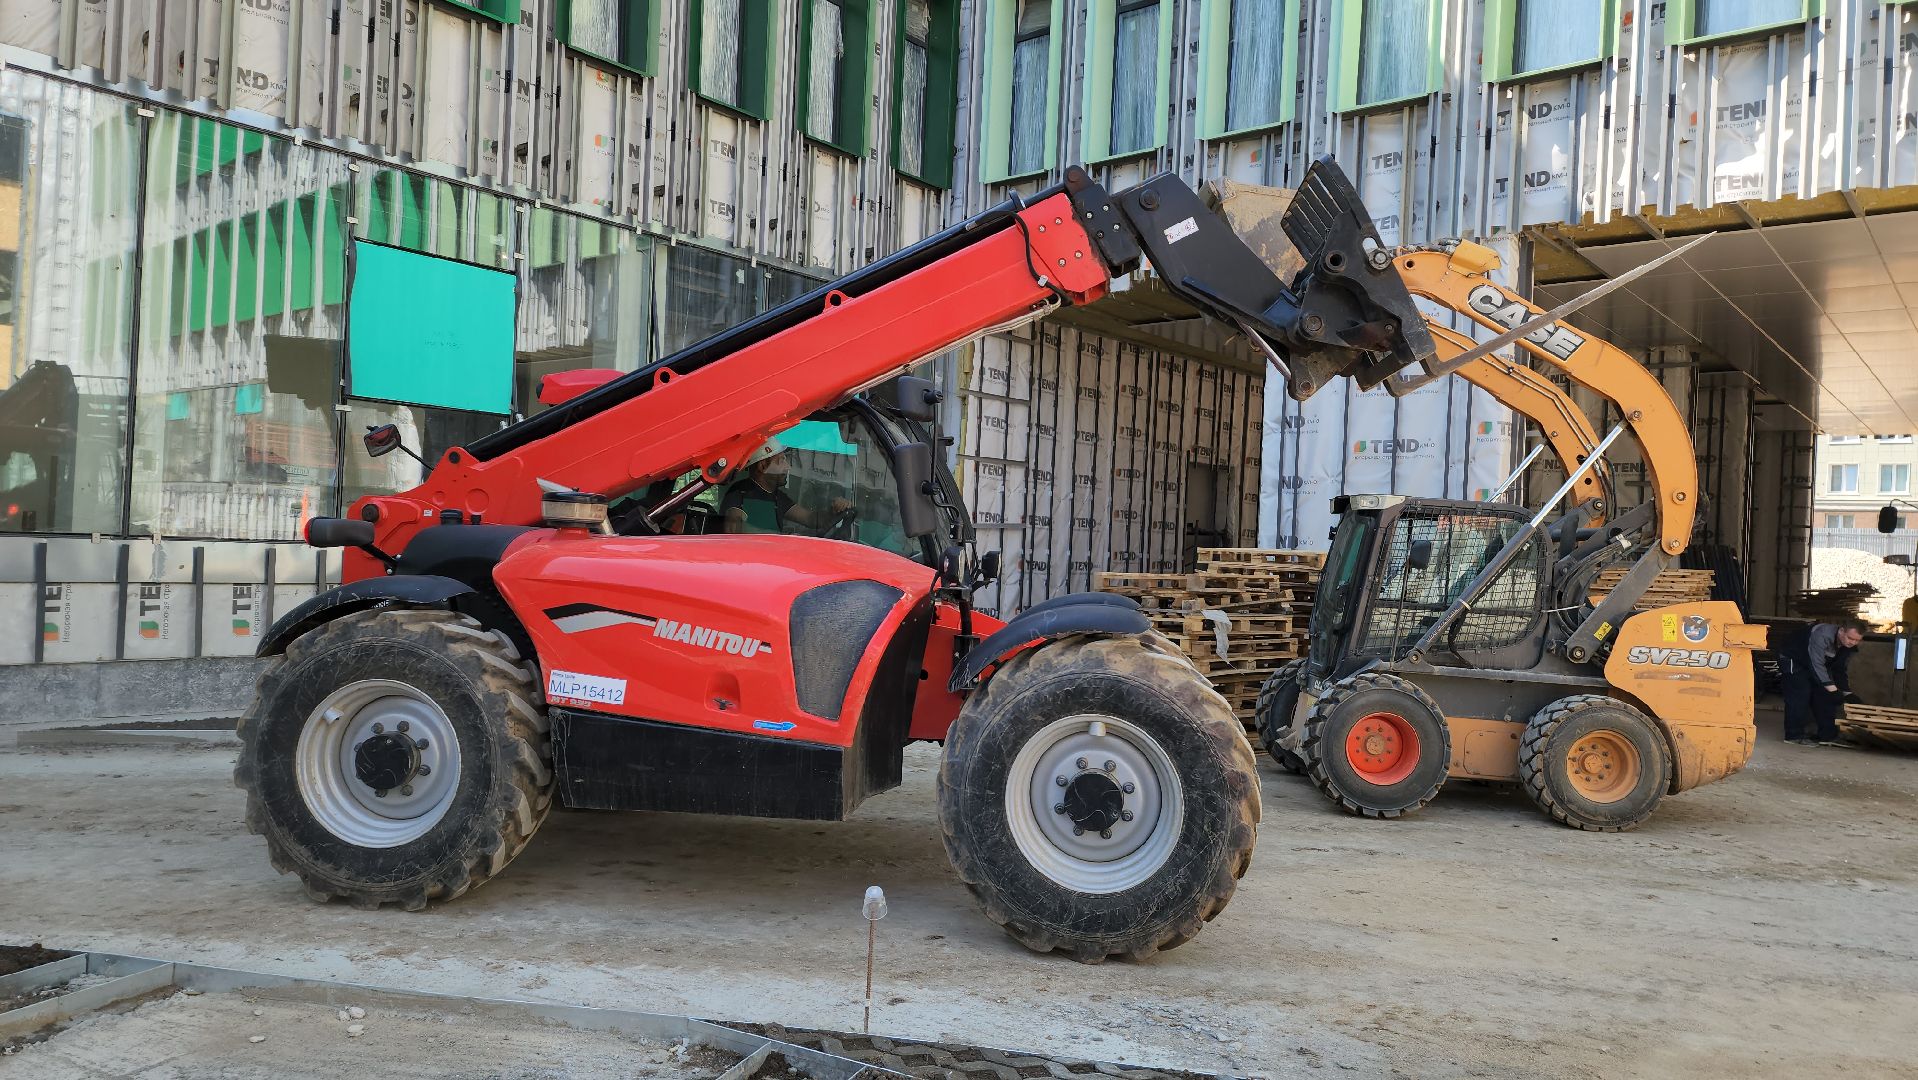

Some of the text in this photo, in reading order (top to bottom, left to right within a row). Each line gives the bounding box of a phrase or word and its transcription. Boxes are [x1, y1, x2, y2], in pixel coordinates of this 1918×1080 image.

[1468, 284, 1586, 362] CASE
[1371, 438, 1420, 454] TEND
[653, 618, 762, 657] MANITOU
[1626, 646, 1731, 669] SV250
[550, 680, 623, 702] MLP15412
